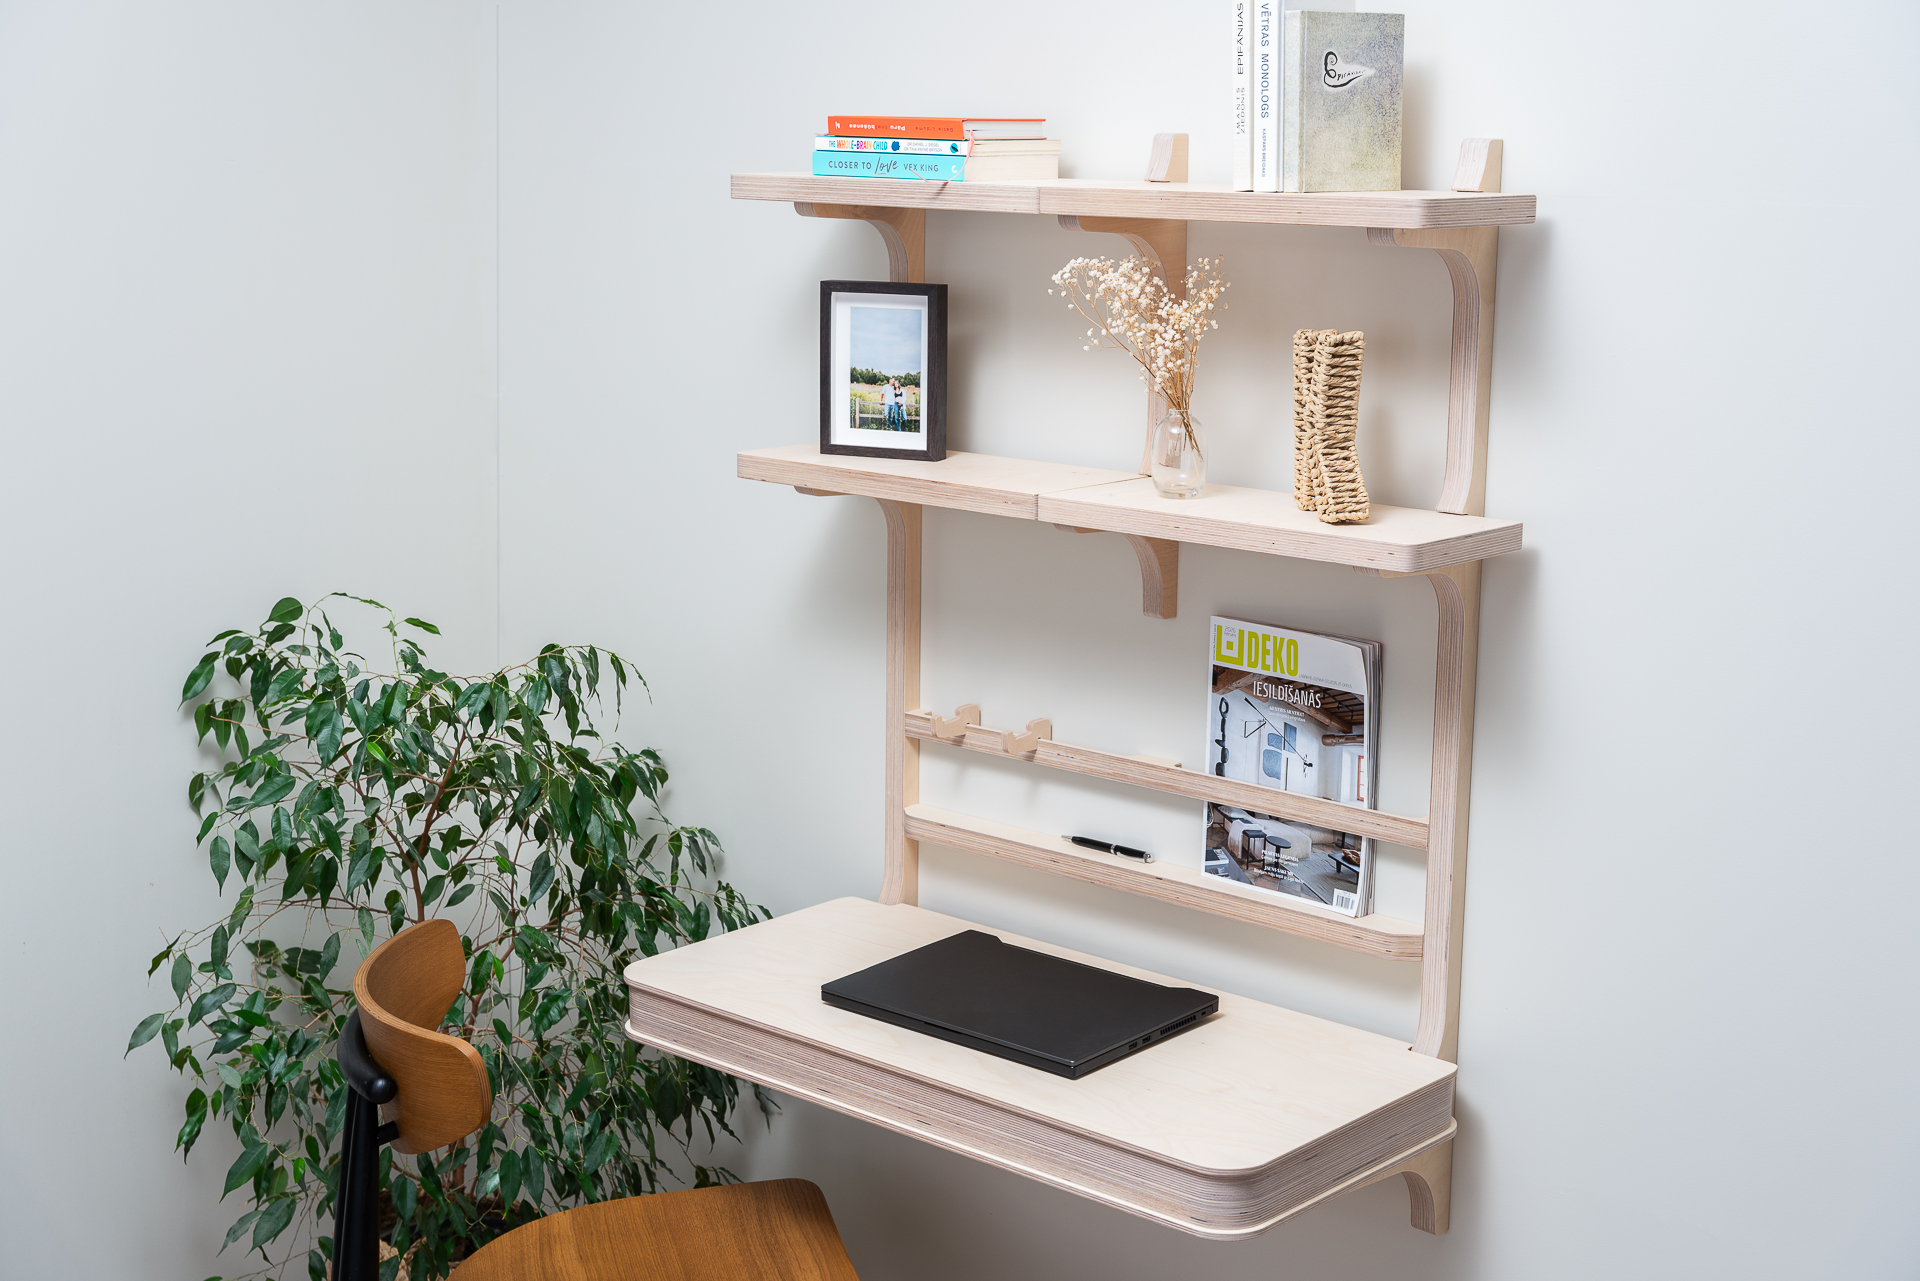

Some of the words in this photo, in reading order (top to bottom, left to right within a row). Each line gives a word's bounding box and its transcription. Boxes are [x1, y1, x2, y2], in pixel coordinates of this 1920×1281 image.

[1261, 2, 1272, 47] VĒTRAS
[1261, 53, 1270, 119] MONOLOGS
[836, 139, 872, 150] WHOLE-BRAIN
[873, 140, 888, 151] CHILD
[828, 160, 859, 169] CLOSER
[861, 161, 872, 170] TO
[874, 156, 899, 175] love
[903, 163, 918, 172] VEX
[920, 163, 939, 172] KING
[1247, 630, 1299, 677] DEKO
[1253, 680, 1322, 709] IESILDĪŠANĀS
